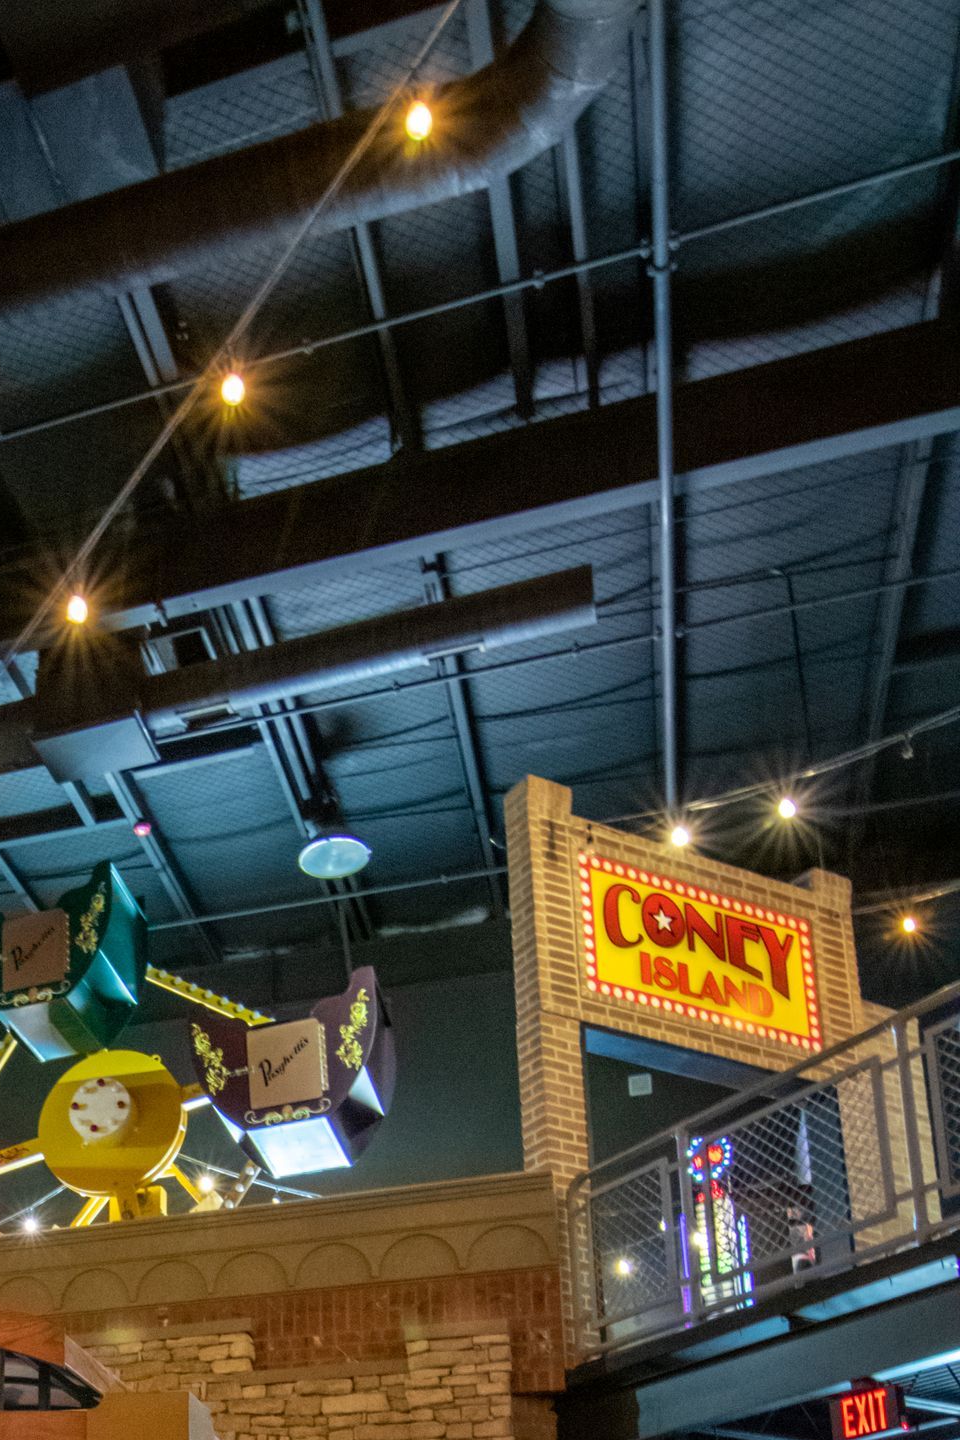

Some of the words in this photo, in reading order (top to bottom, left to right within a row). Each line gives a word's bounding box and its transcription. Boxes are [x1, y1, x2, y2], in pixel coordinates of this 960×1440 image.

[603, 884, 794, 1001] CONEY
[640, 952, 774, 1018] ISLAND
[841, 1388, 887, 1439] EXIT
